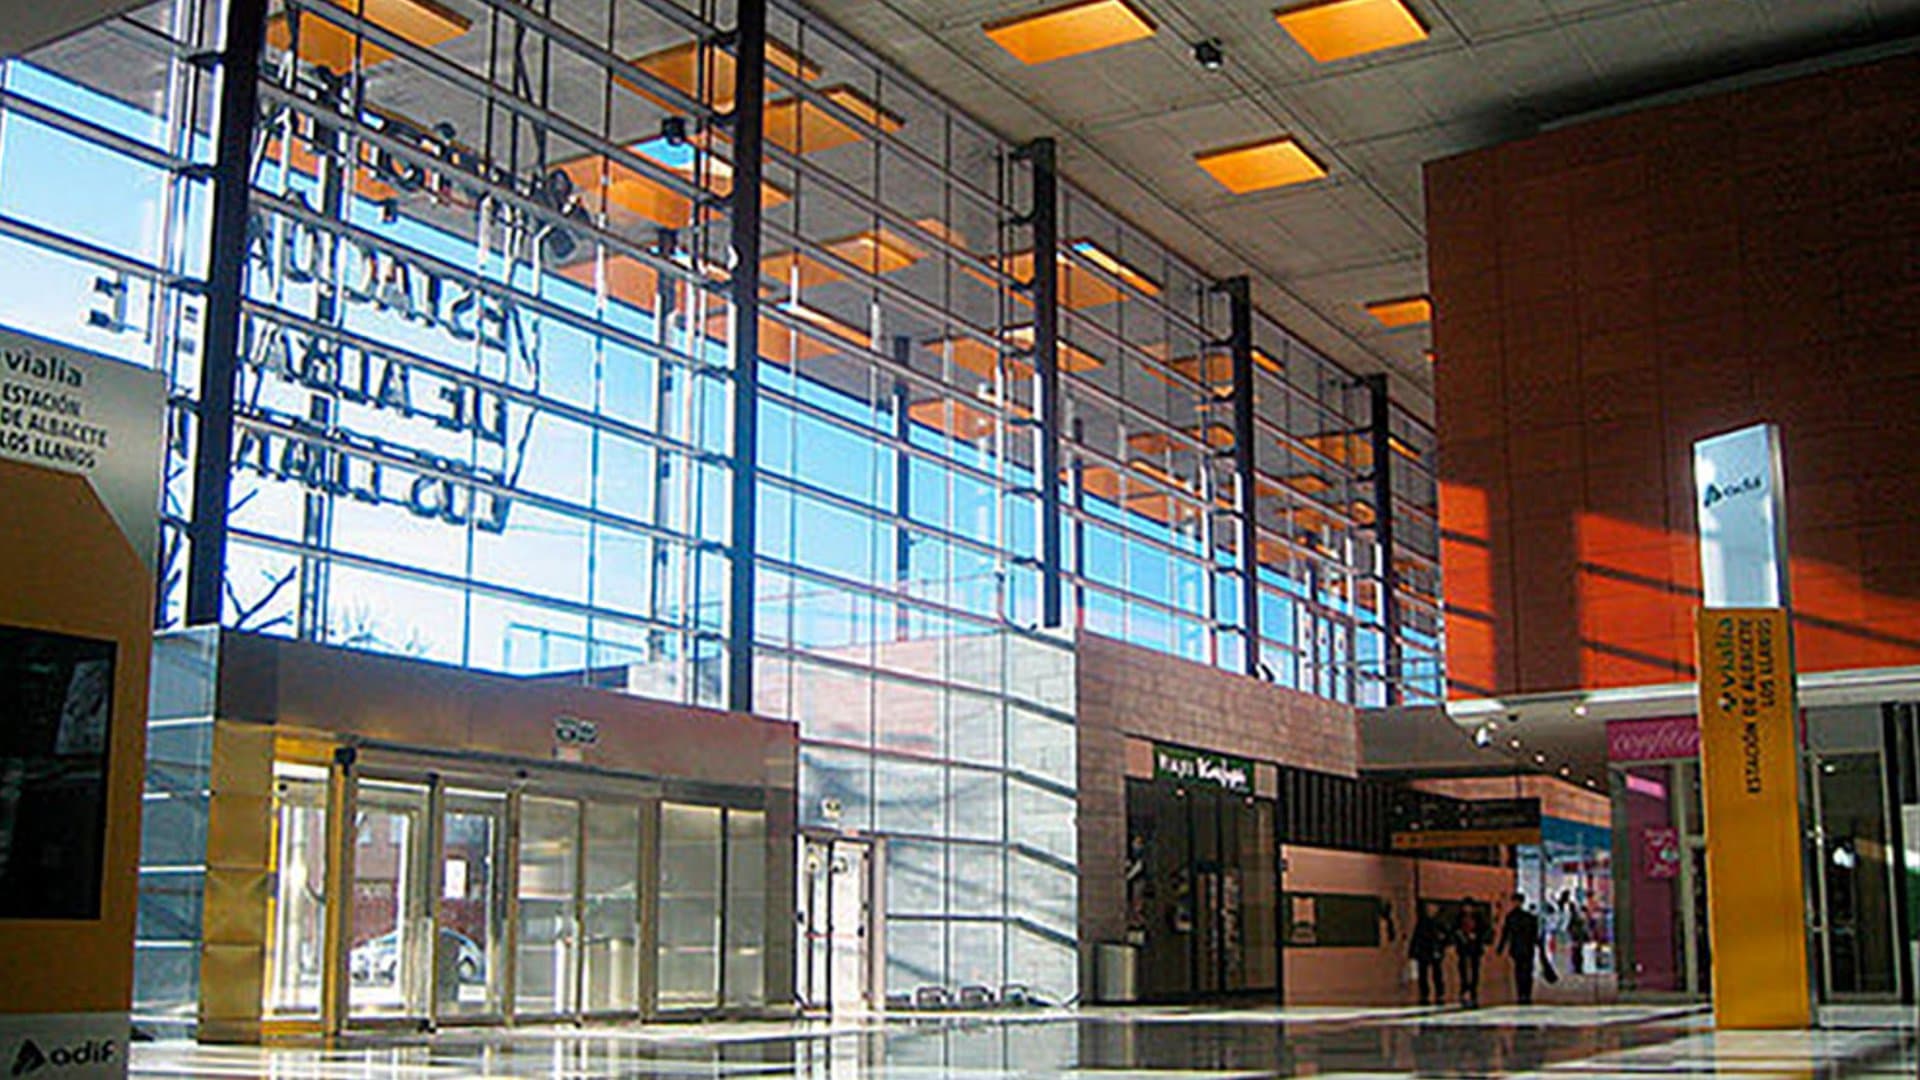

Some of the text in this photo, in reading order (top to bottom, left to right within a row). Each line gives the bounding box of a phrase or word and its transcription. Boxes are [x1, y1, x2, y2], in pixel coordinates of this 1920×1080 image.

[4, 349, 83, 387] vialia
[3, 381, 81, 417] ESTACIÓN
[0, 405, 107, 448] DE ALBACETE
[0, 429, 96, 469] LOS LLANOS
[50, 1039, 117, 1067] adif
